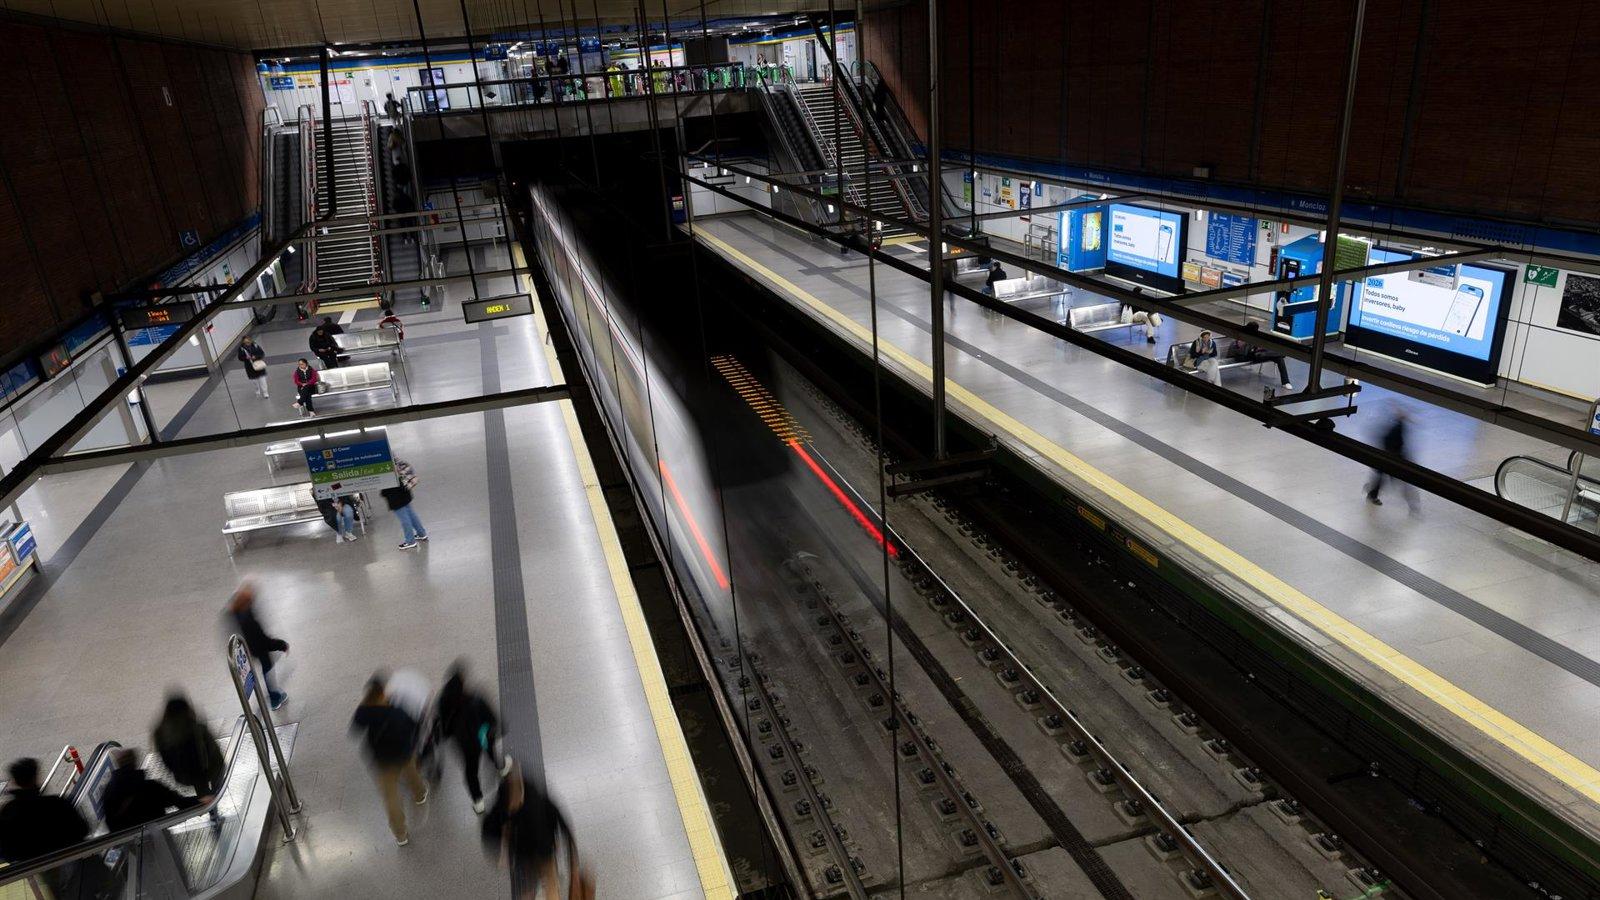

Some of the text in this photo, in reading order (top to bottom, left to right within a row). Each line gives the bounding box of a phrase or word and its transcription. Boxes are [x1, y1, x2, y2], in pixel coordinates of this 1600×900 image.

[1366, 289, 1398, 302] Todos somos
[1392, 302, 1406, 312] baby
[332, 470, 359, 480] Salida
